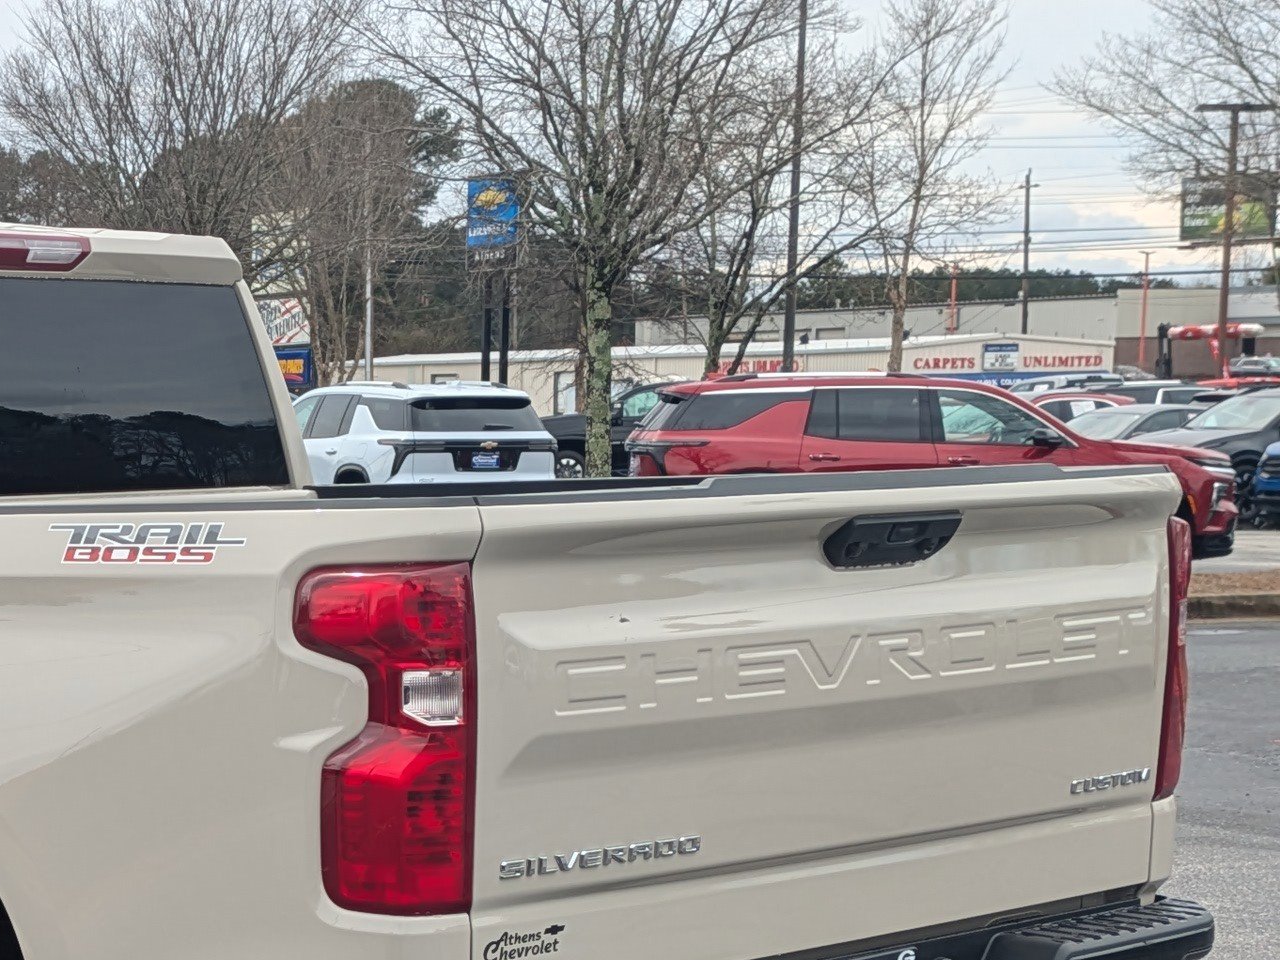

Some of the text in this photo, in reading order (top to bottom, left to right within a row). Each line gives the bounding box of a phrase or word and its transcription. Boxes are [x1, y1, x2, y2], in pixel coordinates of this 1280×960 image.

[913, 357, 976, 370] CARPETS
[1023, 355, 1103, 368] UNLIMITED
[48, 522, 247, 546] TRAIL
[61, 546, 218, 565] BOSS
[554, 604, 1150, 718] CHEVROLET
[499, 834, 702, 880] SILVERADO
[495, 931, 542, 949] Athens
